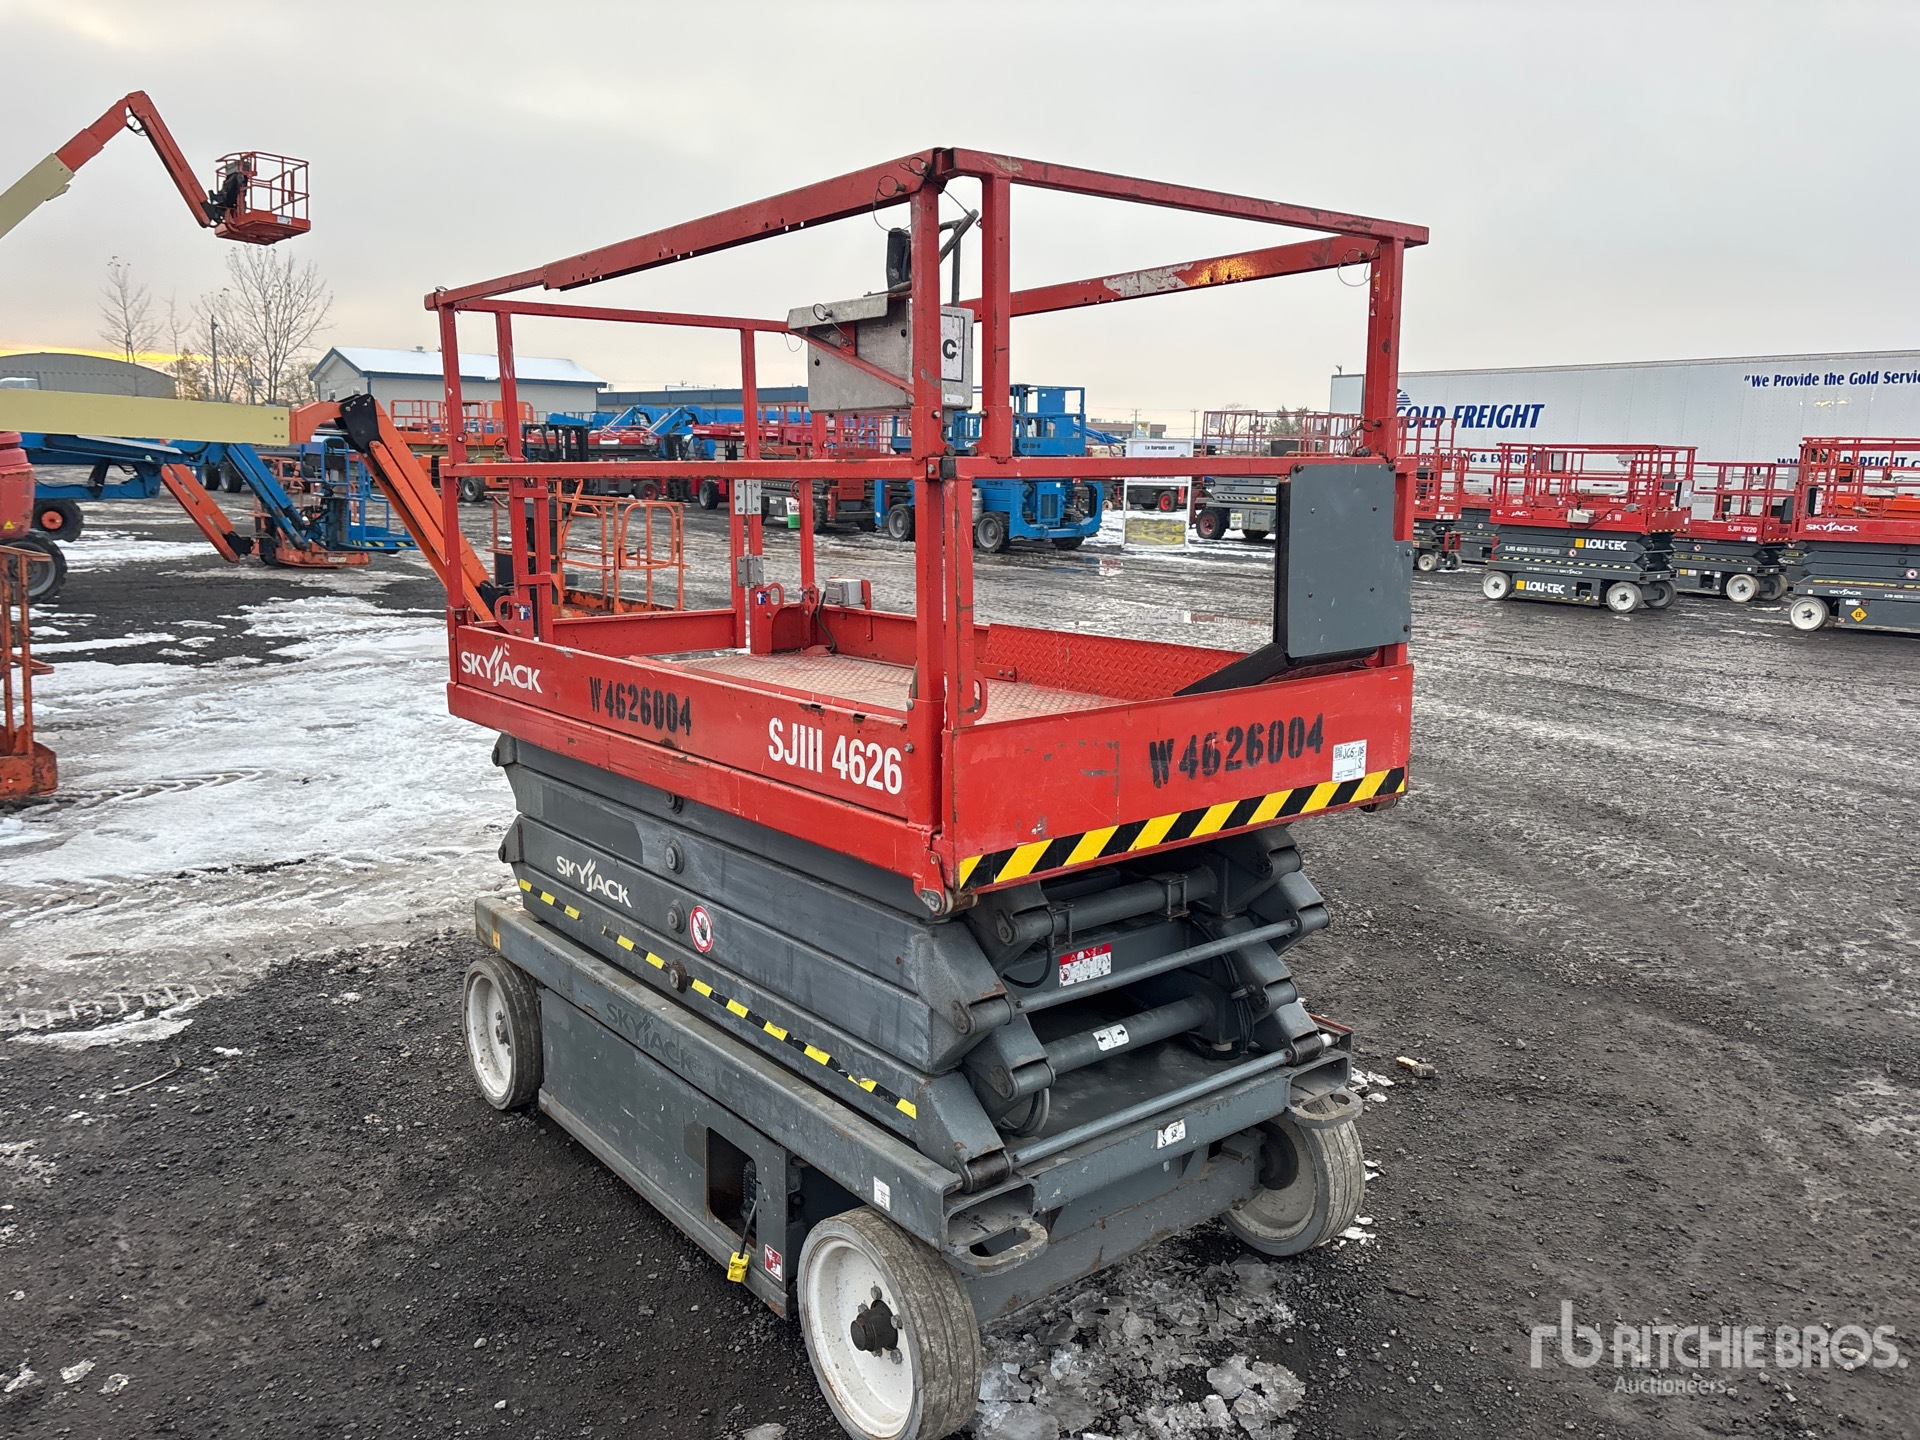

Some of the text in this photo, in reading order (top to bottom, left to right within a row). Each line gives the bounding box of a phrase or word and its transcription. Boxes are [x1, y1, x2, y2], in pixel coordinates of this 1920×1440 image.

[942, 338, 957, 359] C
[1773, 373, 1820, 387] Provide
[1824, 372, 1845, 386] the
[1850, 371, 1879, 385] Gold
[1453, 404, 1545, 428] FREIGHT
[1480, 454, 1487, 463] &
[1806, 521, 1859, 532] SKYJACK
[1829, 588, 1862, 596] SKYJACK
[461, 643, 543, 694] SKYJACK
[768, 717, 903, 795] SJIII 4626
[556, 855, 633, 908] SKYJACK
[607, 1003, 697, 1078] SKYJACK
